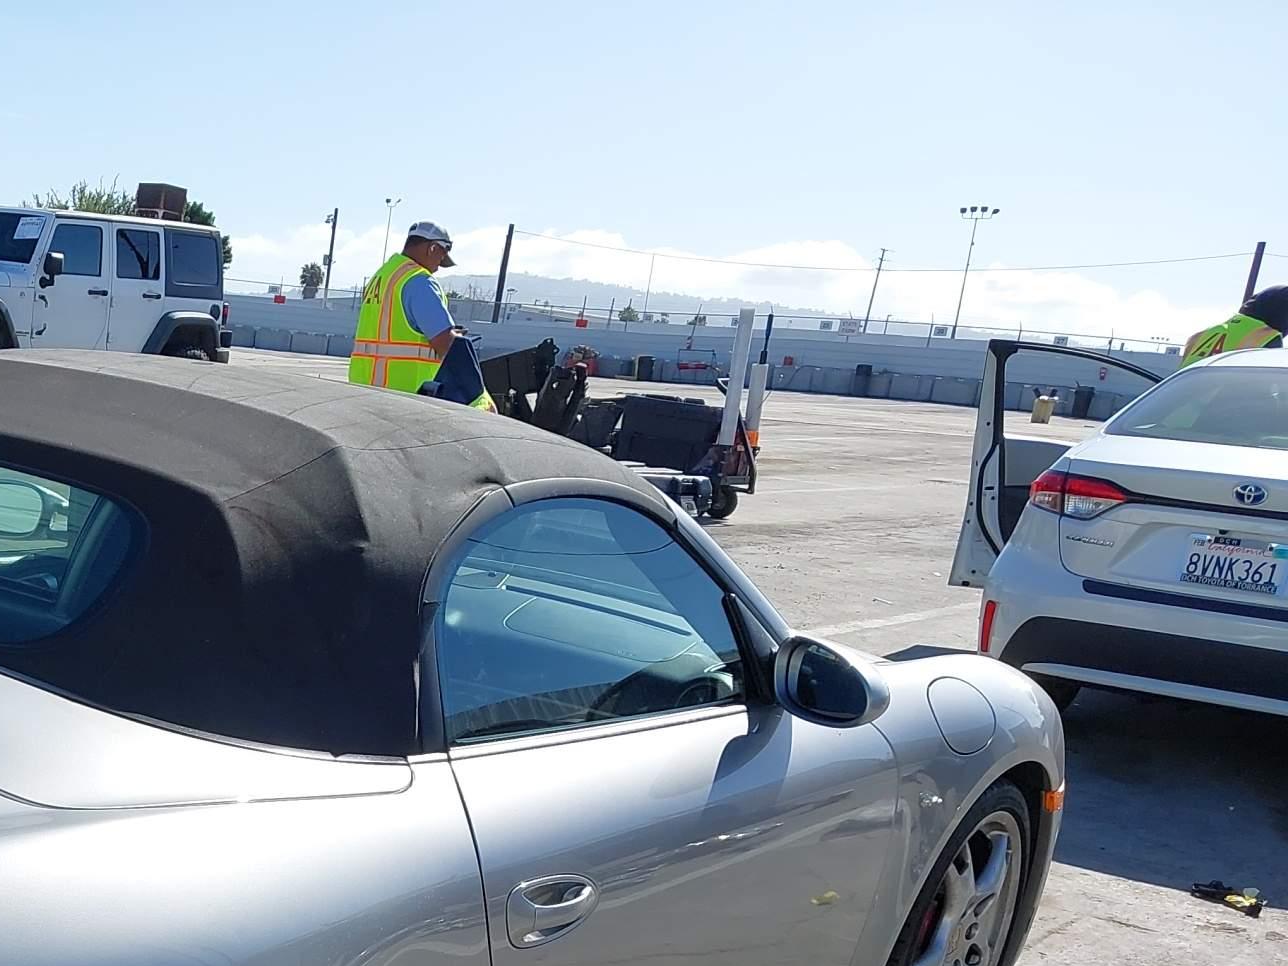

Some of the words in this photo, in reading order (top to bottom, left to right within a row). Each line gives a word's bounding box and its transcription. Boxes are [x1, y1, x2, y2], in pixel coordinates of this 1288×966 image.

[1186, 552, 1277, 584] 8VNK361
[1181, 574, 1197, 583] DCH
[1198, 576, 1225, 587] TOYOTA
[1237, 581, 1277, 594] TORRANCE
